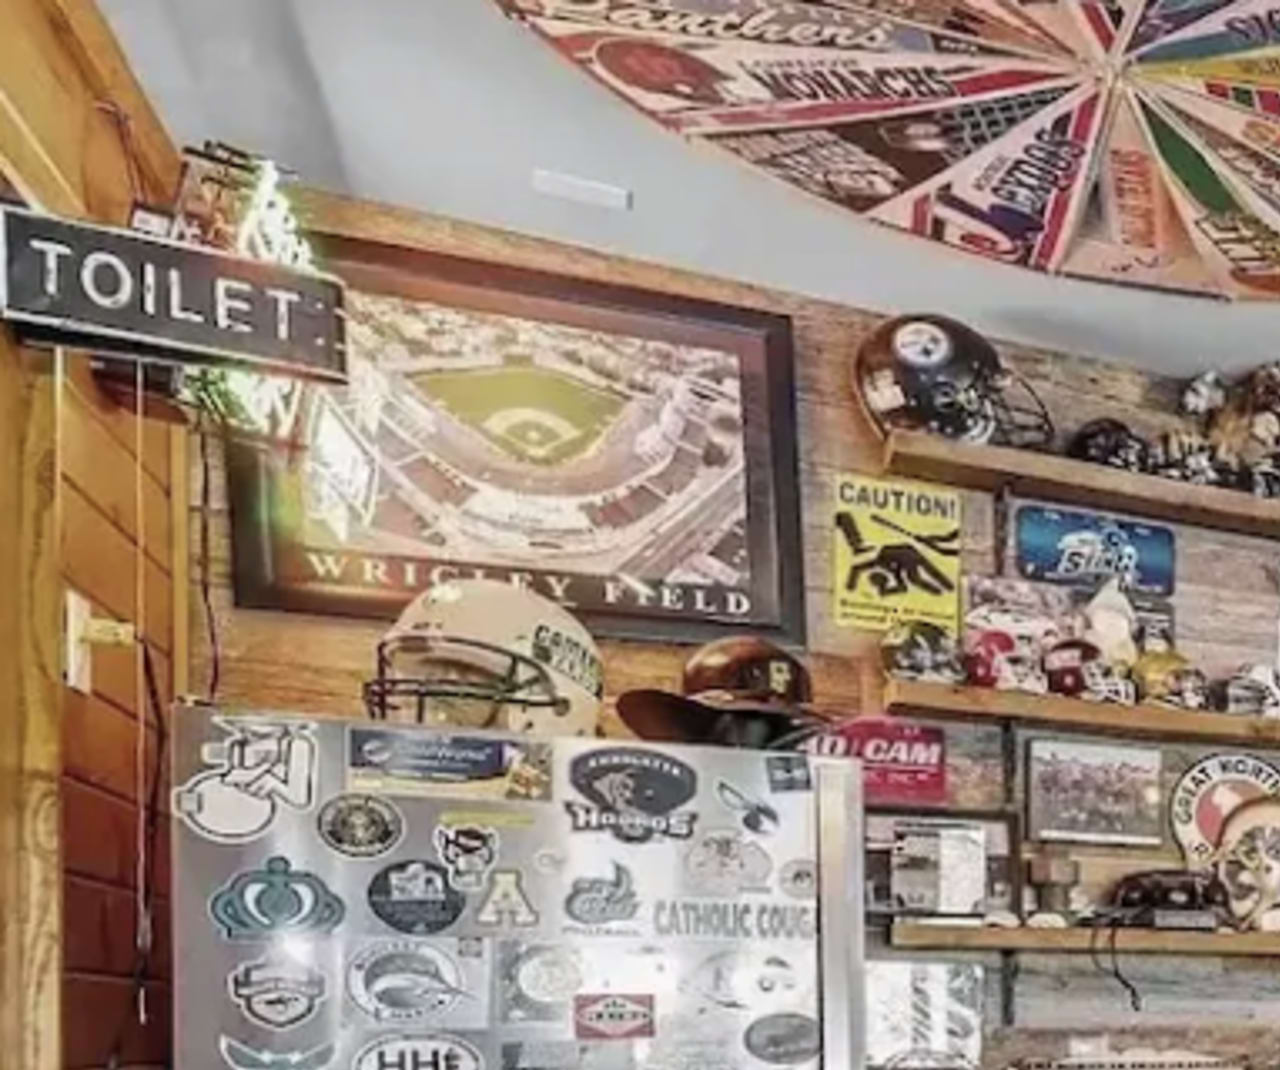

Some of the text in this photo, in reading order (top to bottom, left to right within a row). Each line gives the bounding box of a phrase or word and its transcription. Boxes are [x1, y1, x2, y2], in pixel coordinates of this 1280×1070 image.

[750, 62, 954, 102] MONARCHS
[29, 237, 302, 341] TOILET
[839, 481, 957, 518] CAUTION!
[306, 553, 752, 615] WRIGLEY FIELD
[866, 740, 942, 765] CAM
[1174, 766, 1214, 826] GREAT
[653, 901, 751, 938] CATHOLIC
